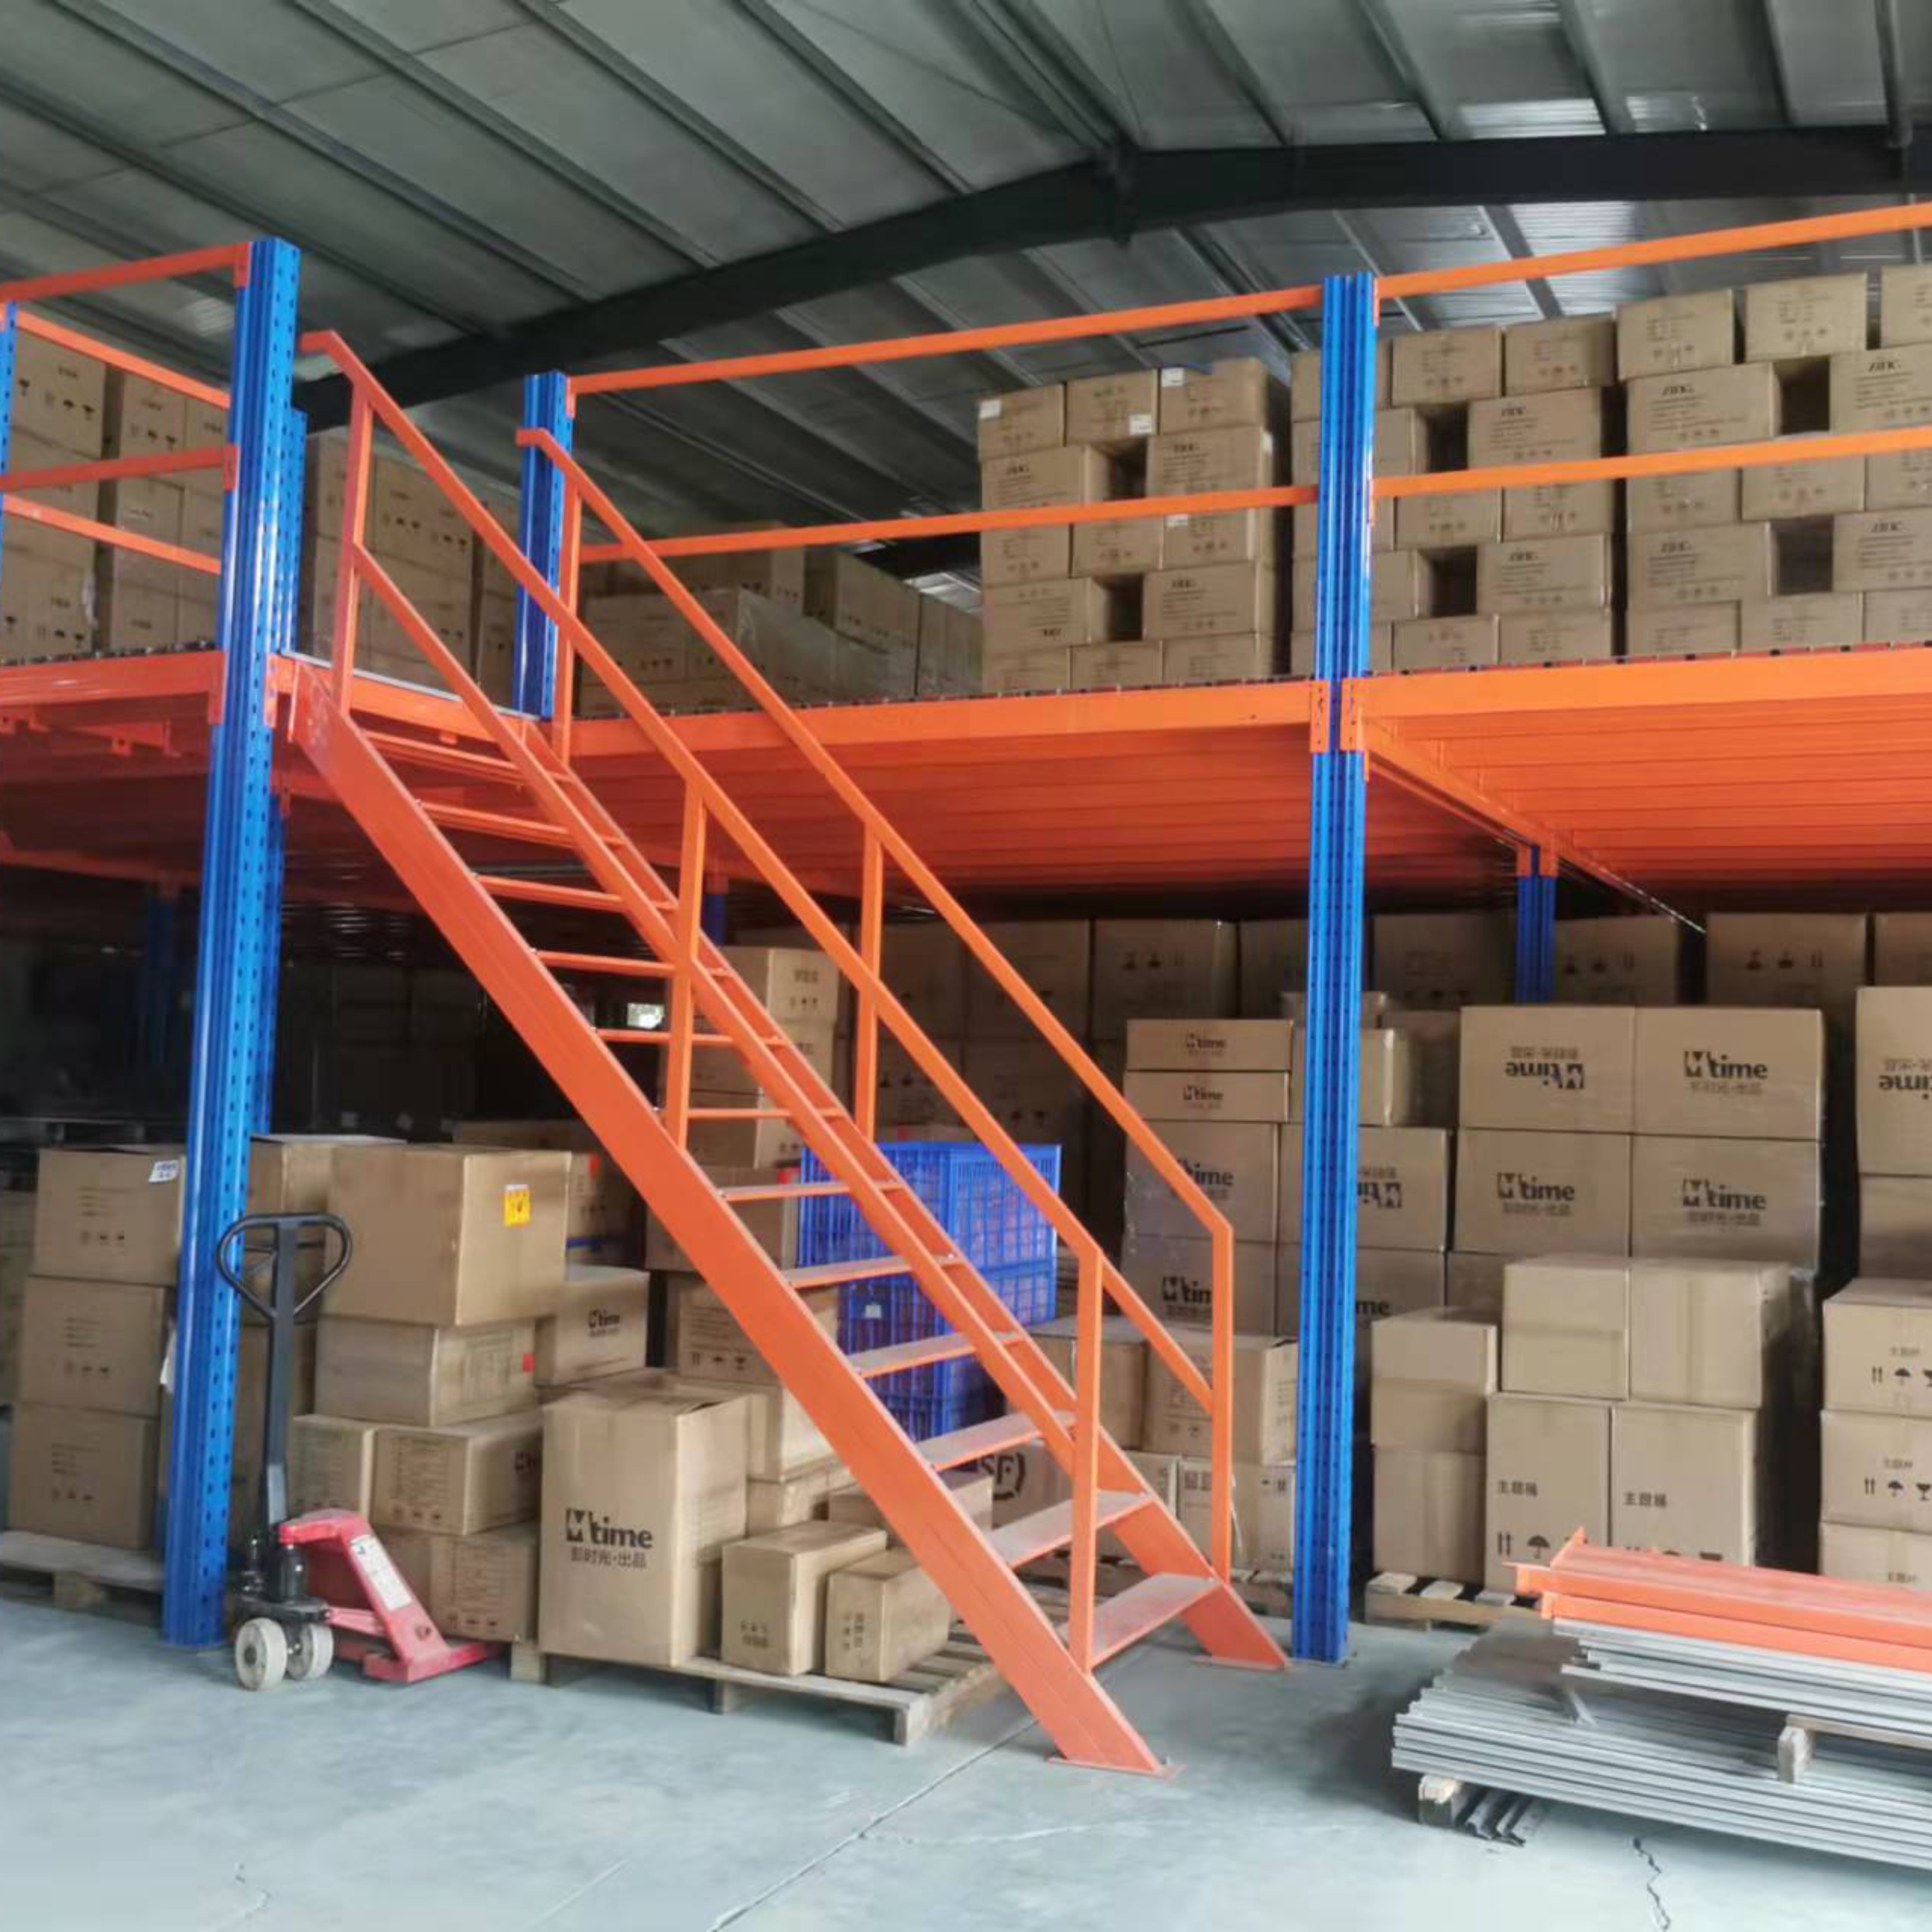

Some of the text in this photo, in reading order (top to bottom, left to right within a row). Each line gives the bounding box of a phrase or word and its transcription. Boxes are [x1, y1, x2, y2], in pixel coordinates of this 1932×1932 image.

[1506, 1062, 1585, 1089] Mtime
[1683, 1049, 1769, 1080] Mtime
[1878, 1074, 1932, 1100] ime
[1497, 1172, 1575, 1201] Mtime
[1682, 1178, 1766, 1210] Mtime
[1163, 1275, 1212, 1305] Mtim
[566, 1508, 653, 1549] Mtime
